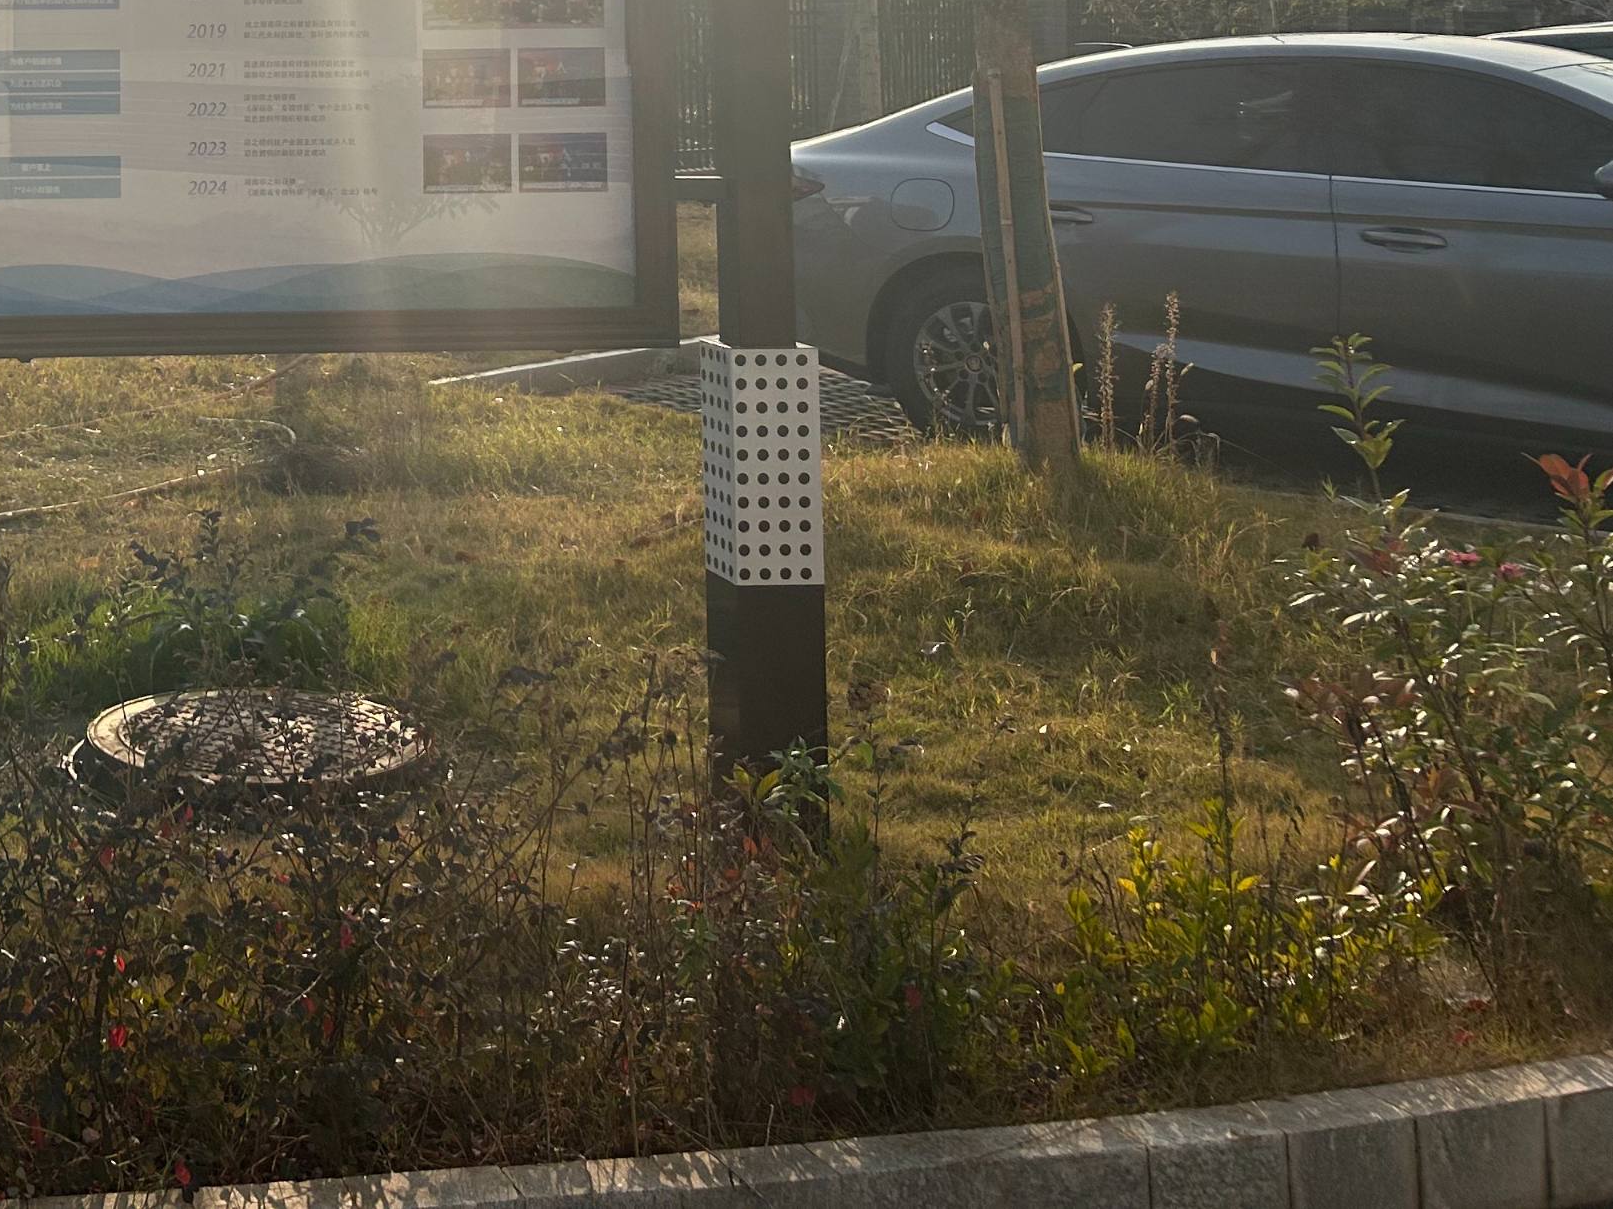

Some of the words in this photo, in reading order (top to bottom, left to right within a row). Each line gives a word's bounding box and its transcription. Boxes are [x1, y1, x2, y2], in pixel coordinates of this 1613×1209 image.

[186, 23, 227, 39] 2019
[187, 63, 226, 78] 2021
[187, 102, 228, 117] 2022
[187, 141, 228, 156] 2023
[187, 180, 228, 196] 2024
